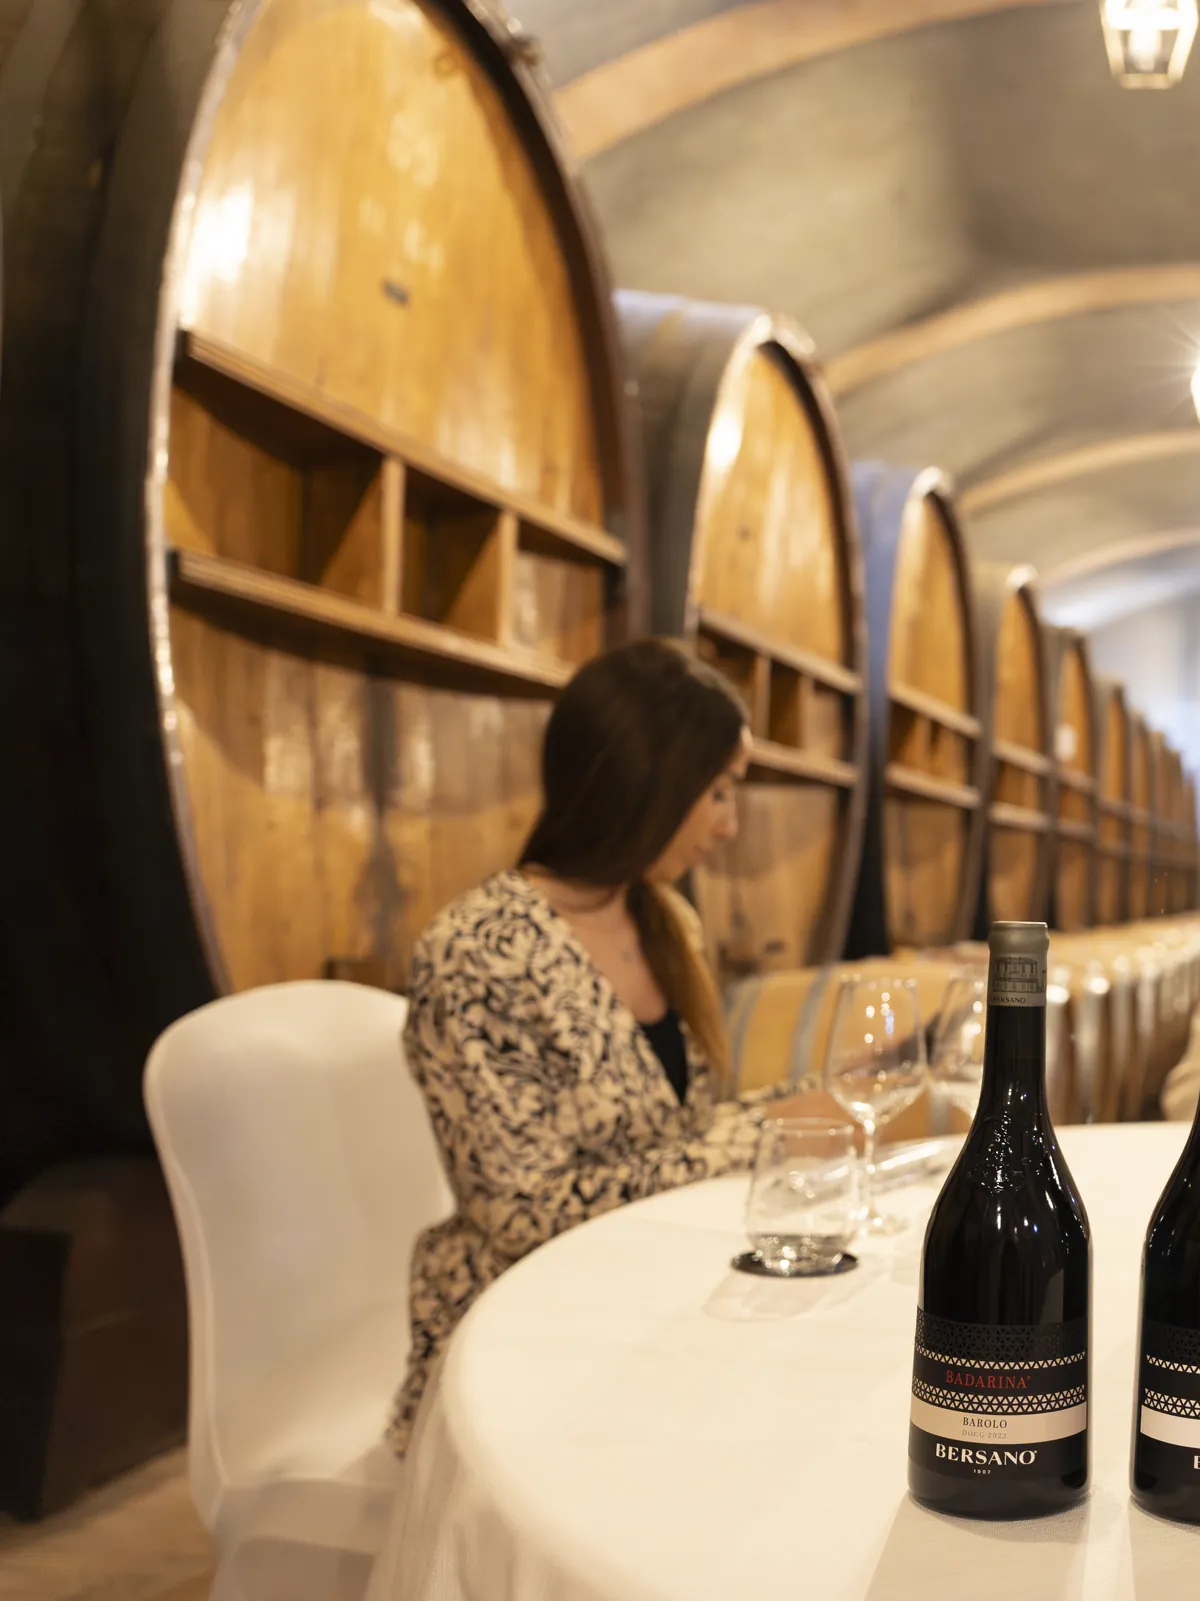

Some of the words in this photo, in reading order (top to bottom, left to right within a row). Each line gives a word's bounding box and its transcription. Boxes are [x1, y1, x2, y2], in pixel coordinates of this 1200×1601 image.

[946, 1369, 1028, 1388] BADARINA
[963, 1417, 1007, 1428] BAROLO
[962, 1430, 984, 1438] DOCG
[935, 1443, 1036, 1465] BERSANO
